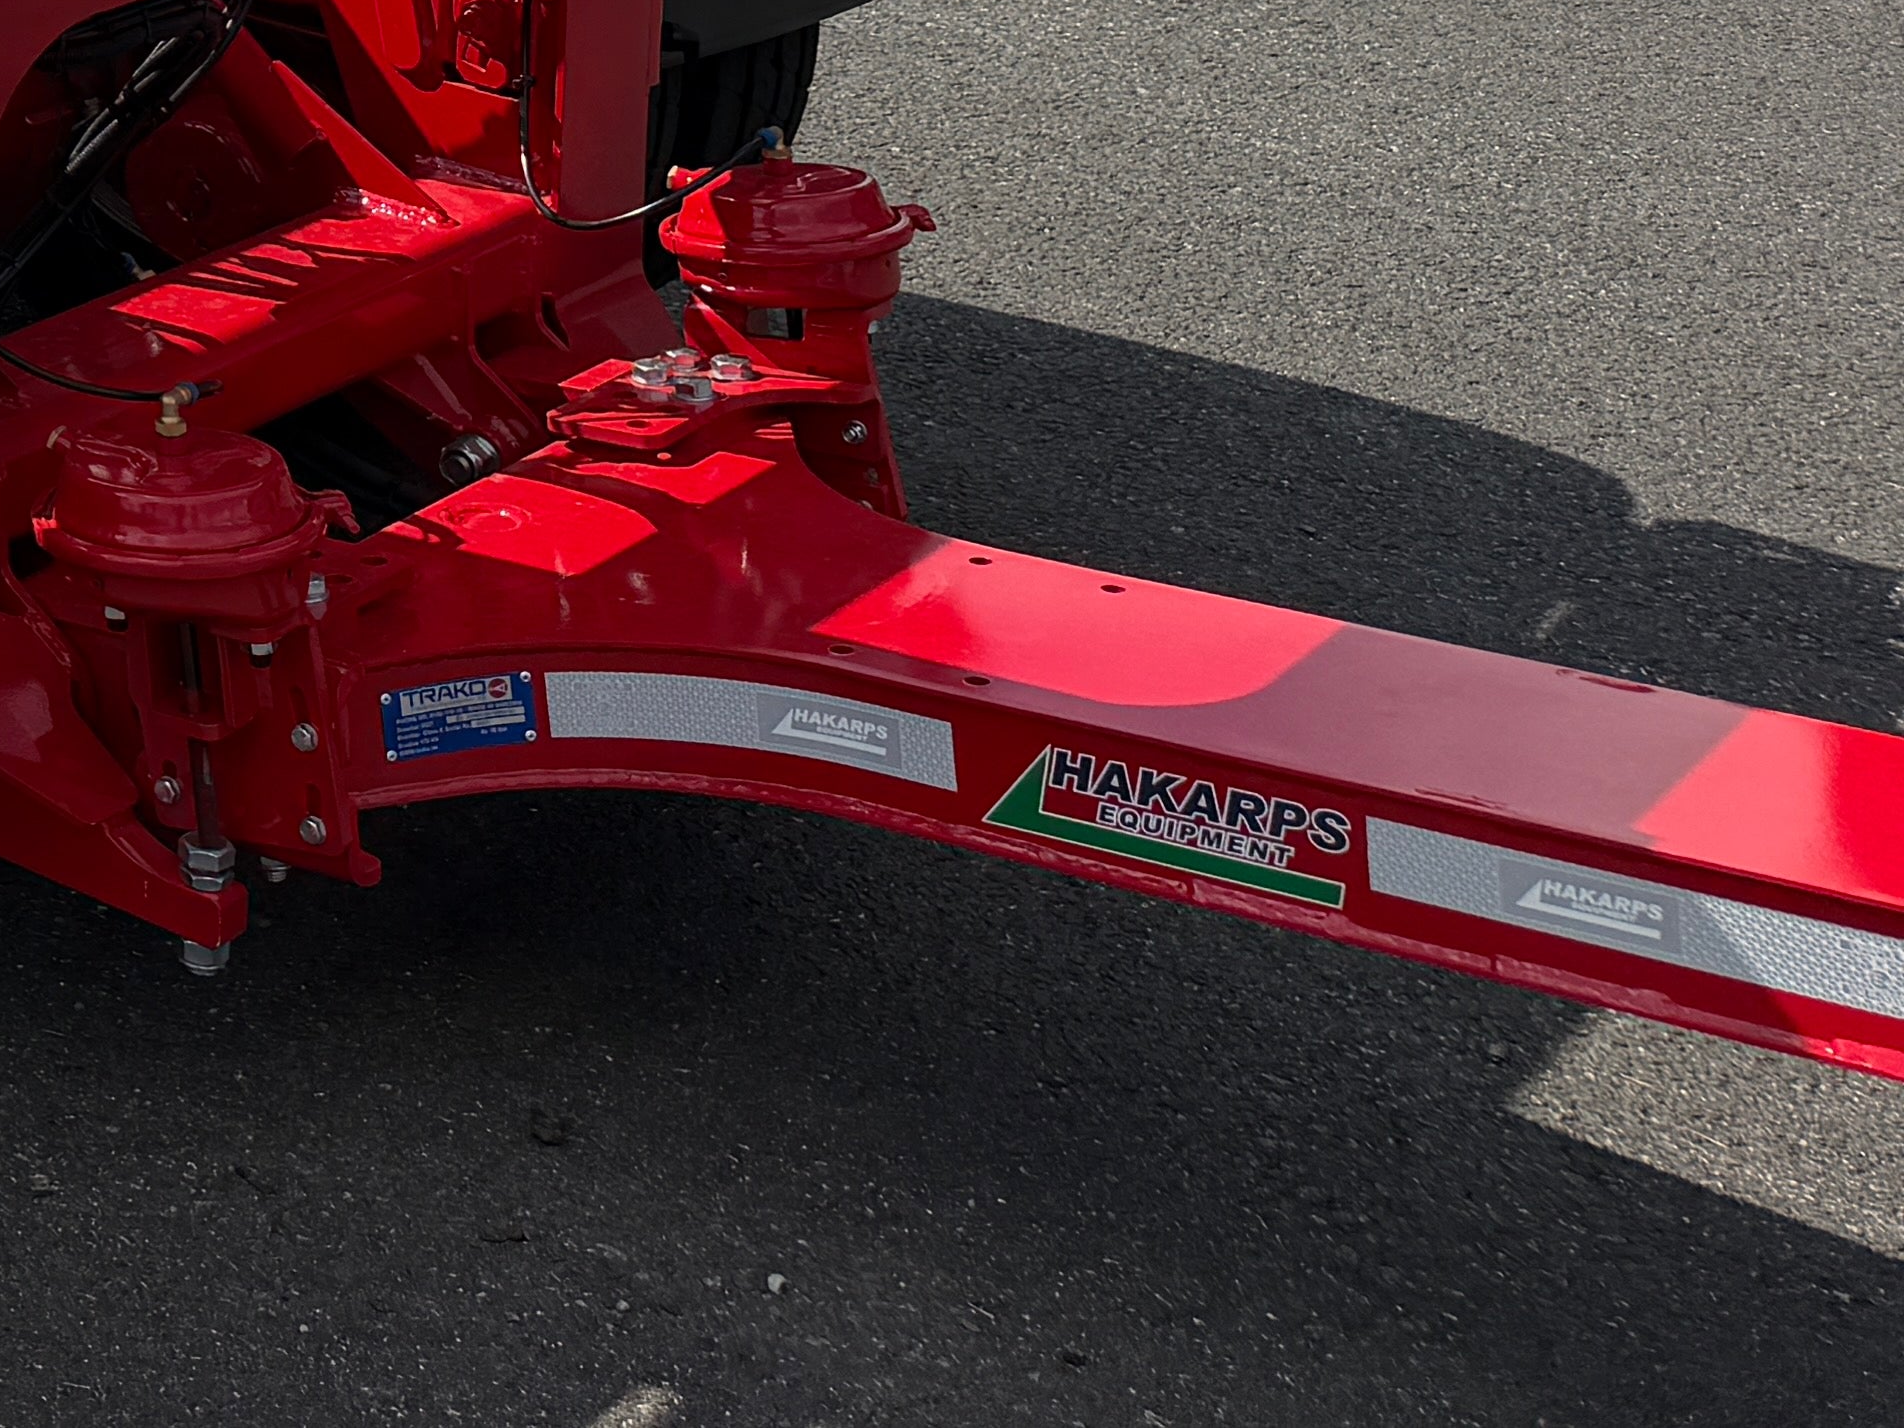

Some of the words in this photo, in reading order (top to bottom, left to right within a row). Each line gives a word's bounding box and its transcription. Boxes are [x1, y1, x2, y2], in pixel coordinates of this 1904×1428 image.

[401, 680, 487, 708] TRAKO
[793, 707, 888, 740] HAKARPS
[1048, 746, 1352, 855] HAKARPS
[1095, 802, 1295, 868] EQUIPMENT
[1543, 878, 1664, 922] HAKARPS
